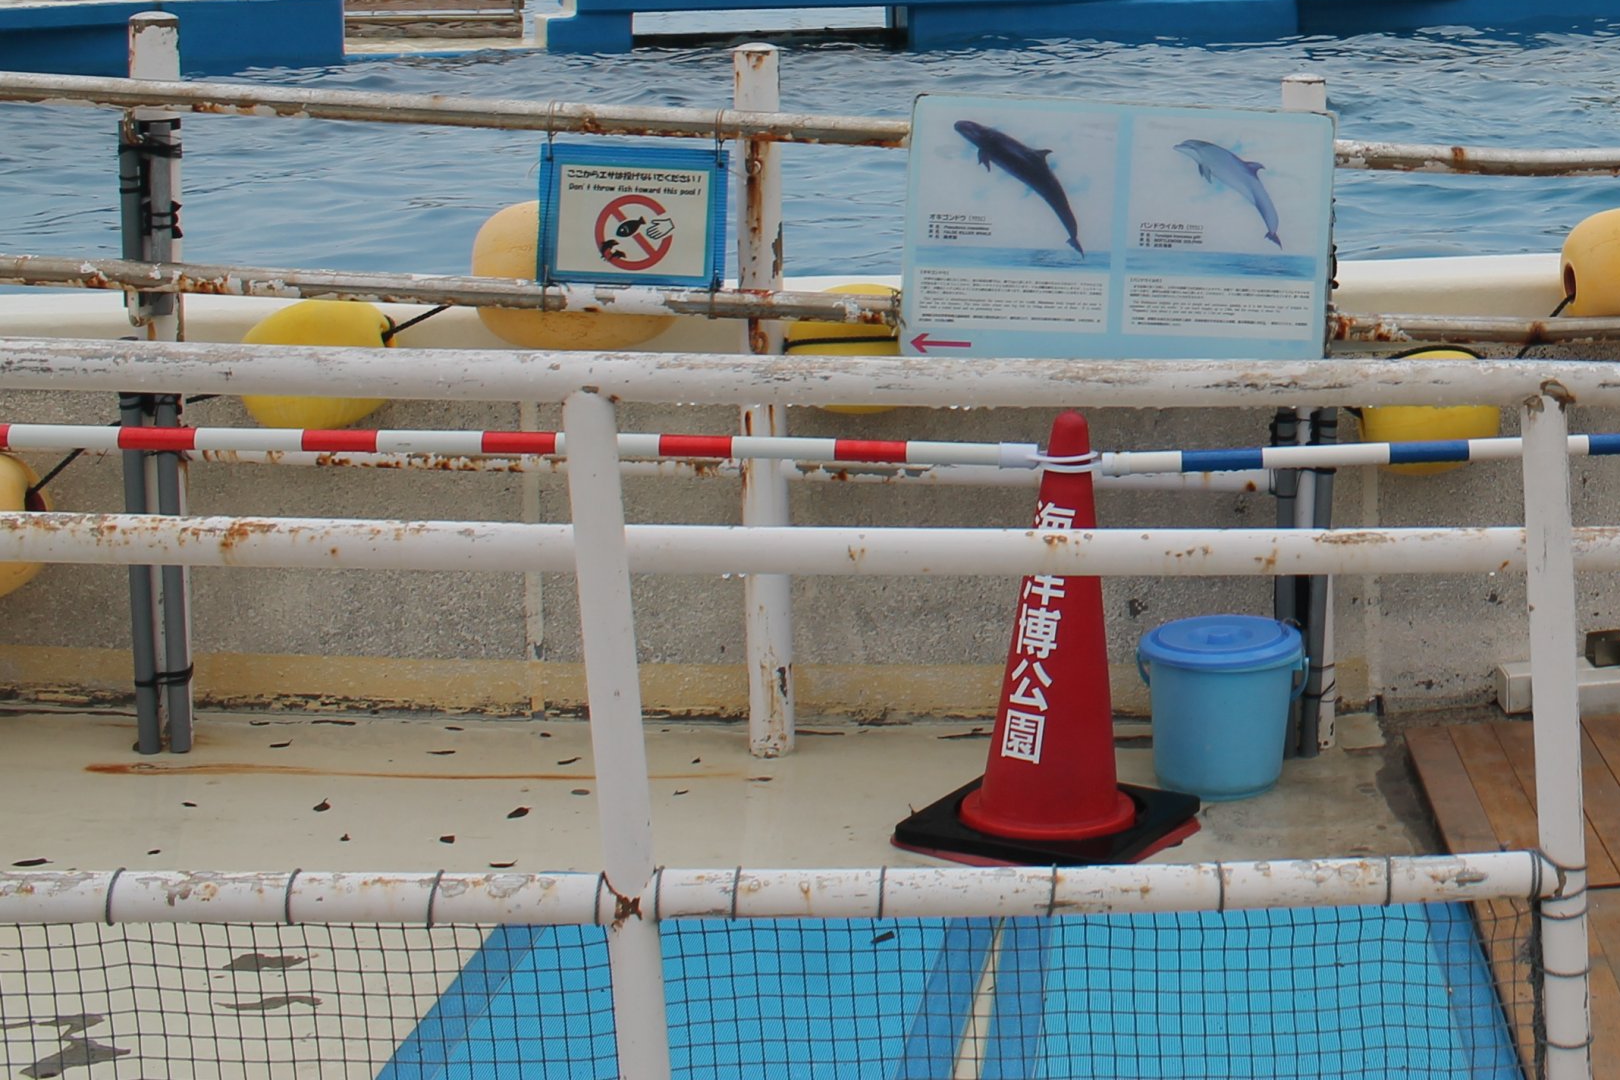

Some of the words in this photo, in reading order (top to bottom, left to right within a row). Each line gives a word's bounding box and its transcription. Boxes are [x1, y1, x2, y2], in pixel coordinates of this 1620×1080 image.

[593, 184, 615, 192] throw
[618, 185, 633, 193] fish
[663, 187, 678, 195] this
